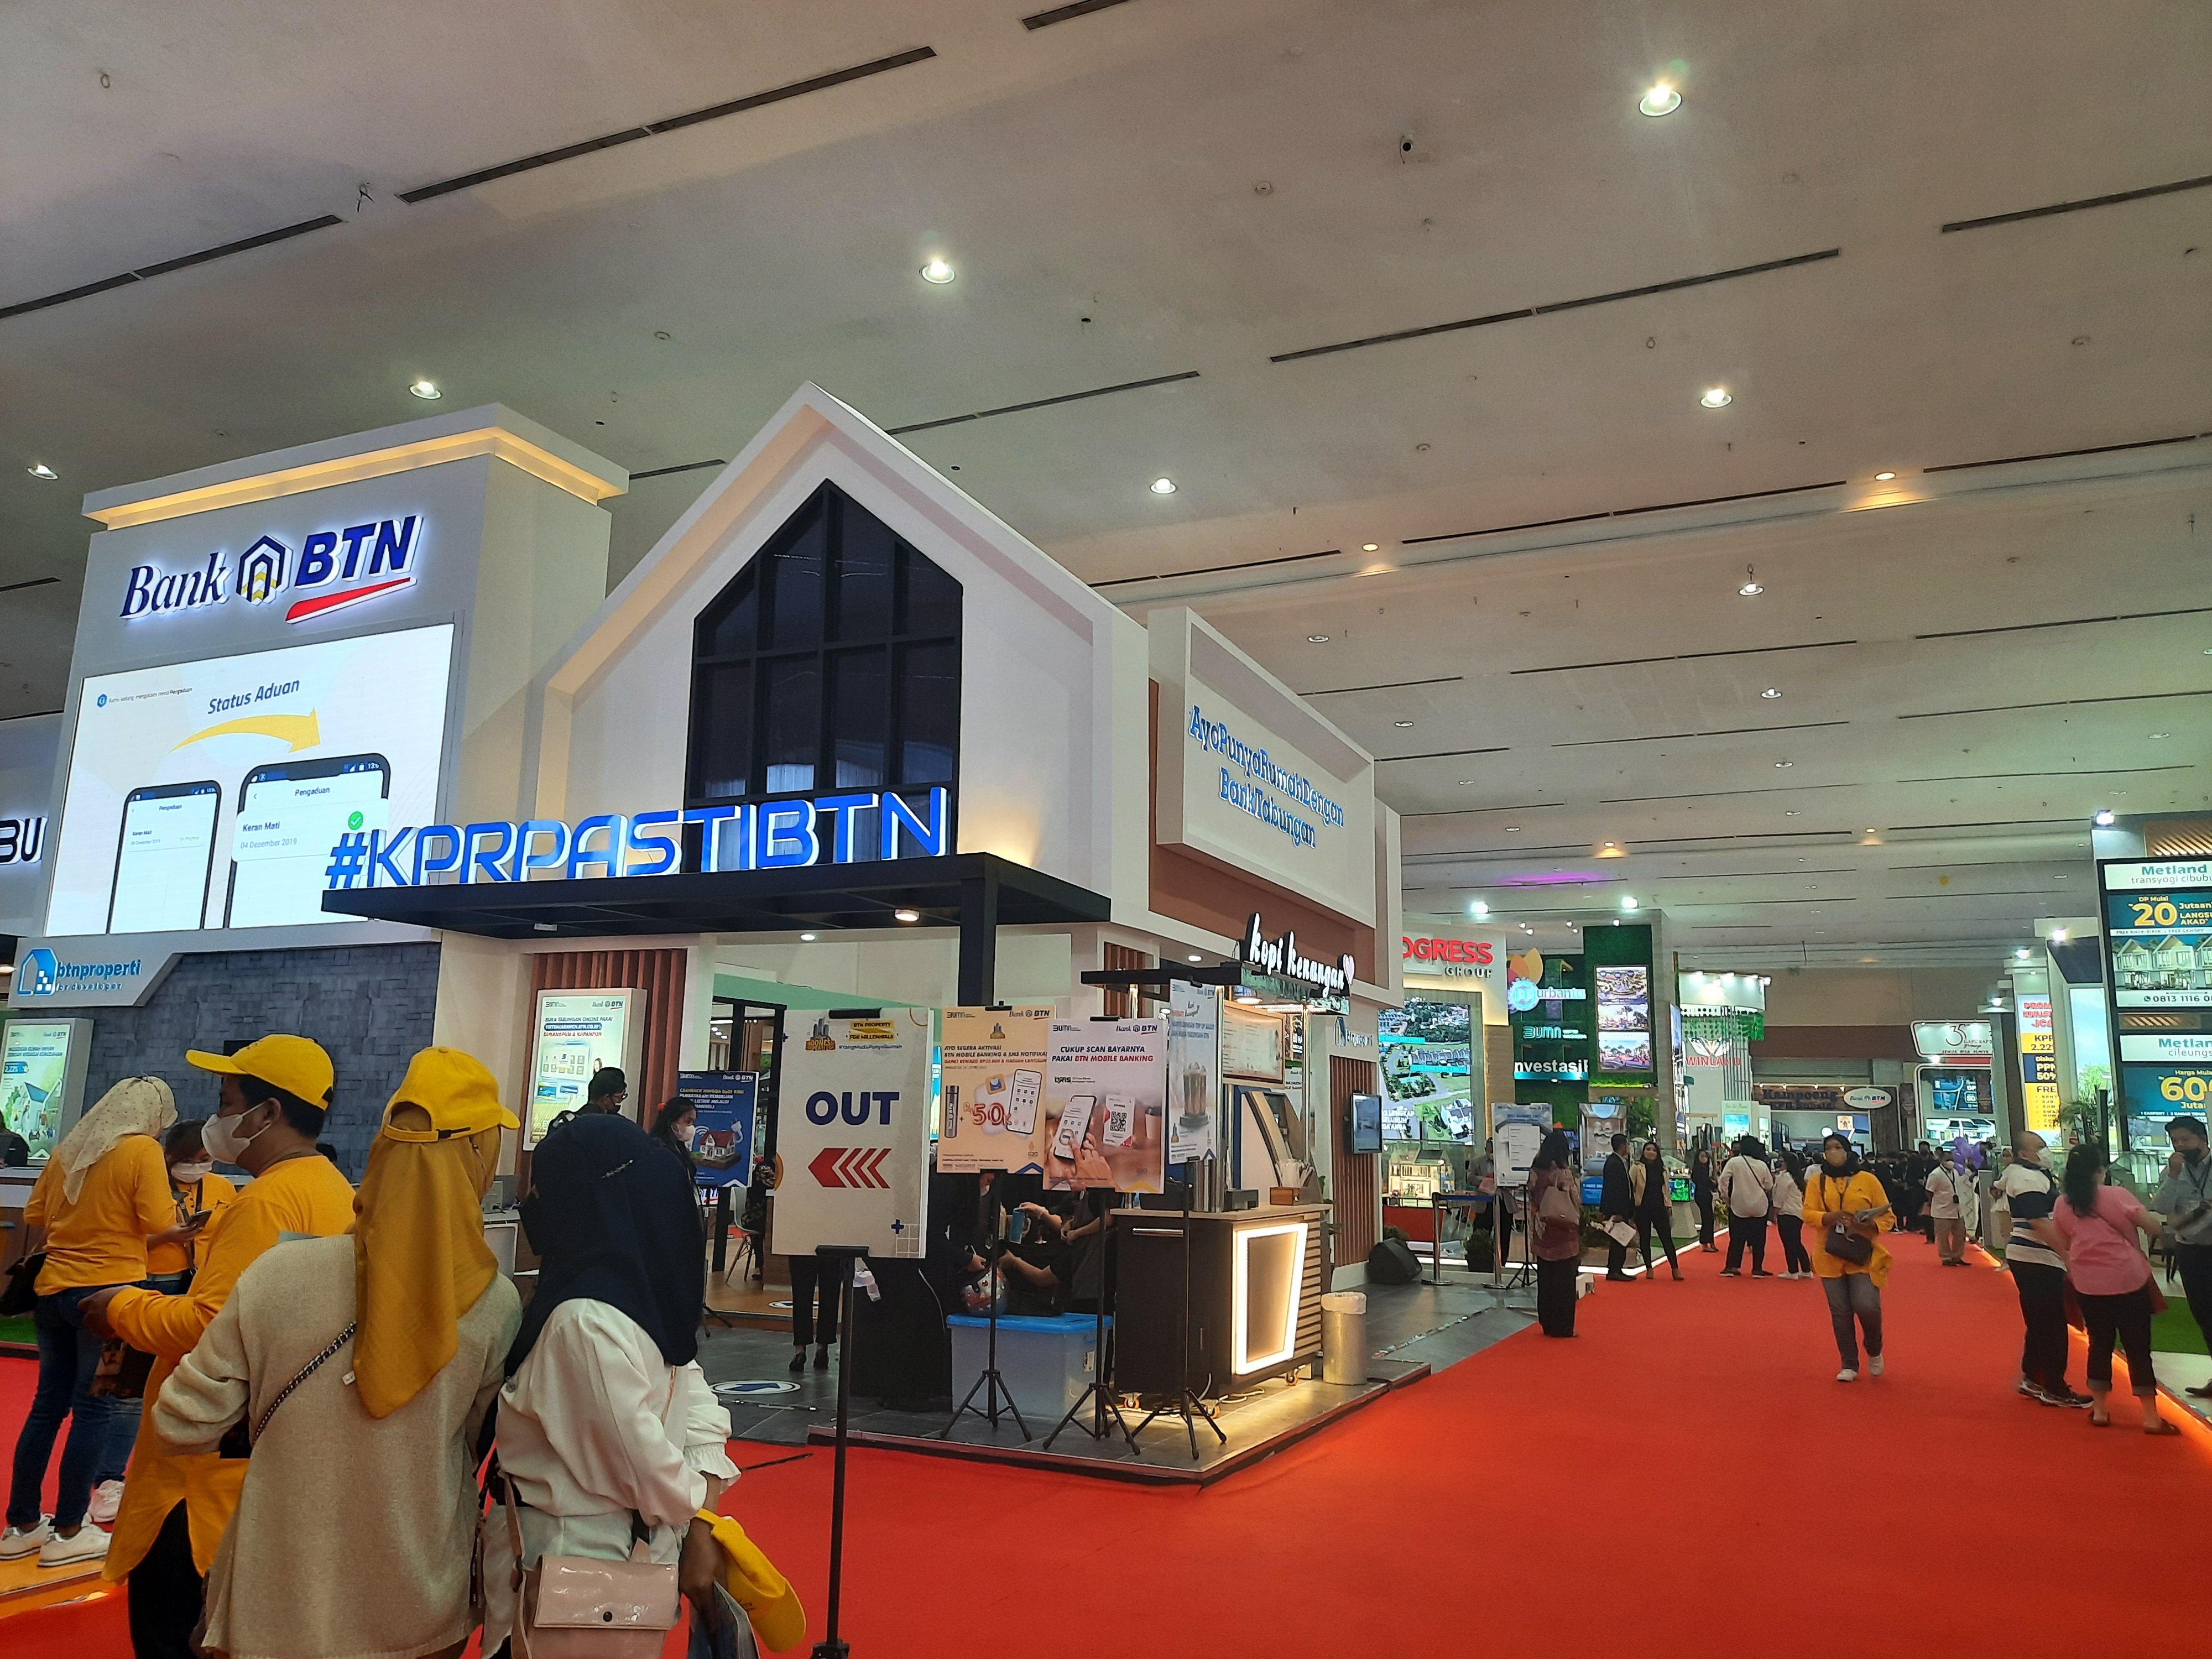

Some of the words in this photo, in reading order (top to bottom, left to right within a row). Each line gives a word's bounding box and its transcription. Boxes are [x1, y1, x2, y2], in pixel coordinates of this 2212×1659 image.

[120, 552, 232, 620] Bank
[294, 515, 423, 589] BTN
[207, 692, 252, 714] Status
[254, 680, 300, 703] Aduan
[295, 786, 330, 797] Pengaduan
[242, 822, 264, 832] Keran
[265, 821, 280, 830] Mati
[240, 841, 248, 849] 04
[249, 839, 280, 848] Desember
[281, 837, 297, 846] 2019
[324, 786, 948, 890] #KPRPASTIBTN
[2141, 864, 2208, 875] Metland
[2131, 875, 2178, 885] transyogi
[2131, 902, 2178, 926] 20
[1249, 912, 1284, 976] kopi
[1286, 930, 1345, 998] kenangan
[56, 959, 142, 980] btnproperti
[1445, 966, 1493, 979] GROUP
[71, 982, 123, 992] developer
[1686, 1056, 1741, 1066] WINLAND
[805, 1091, 900, 1126] OUT
